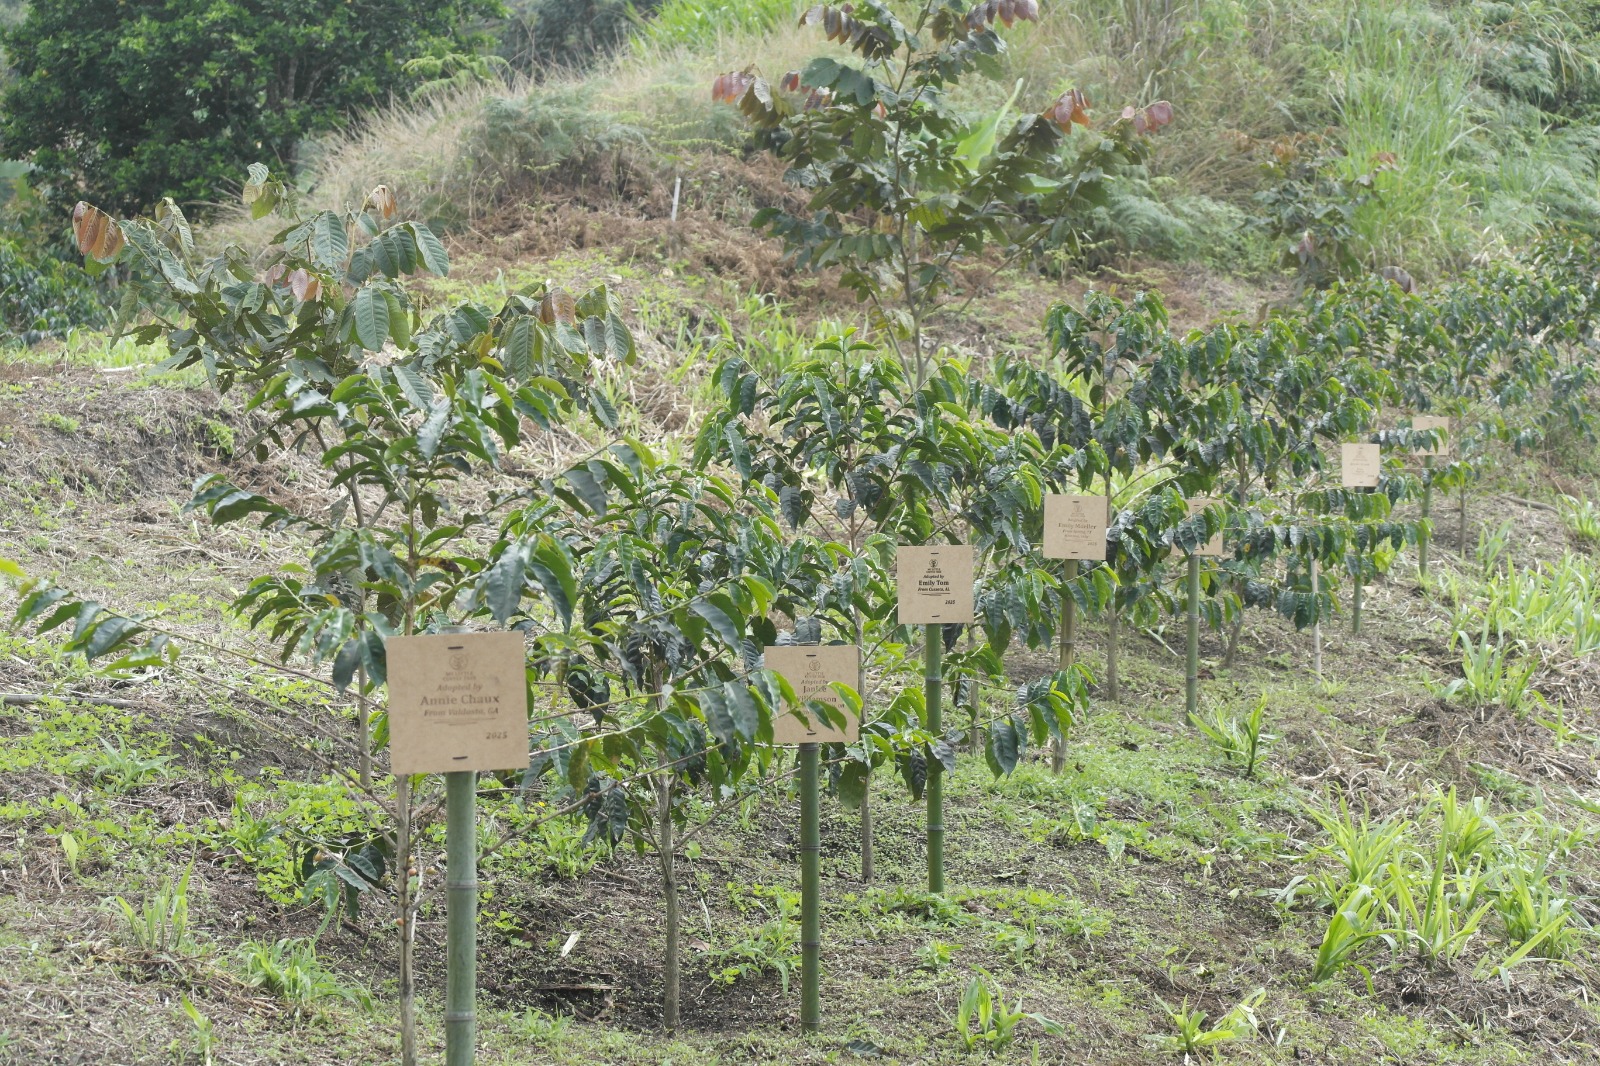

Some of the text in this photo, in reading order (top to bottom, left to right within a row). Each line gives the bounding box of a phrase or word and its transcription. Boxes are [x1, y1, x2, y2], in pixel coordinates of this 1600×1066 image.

[437, 683, 483, 693] Adopted by
[420, 694, 500, 706] Annie Chaux
[424, 709, 446, 717] From
[448, 708, 486, 716] Valdosta,
[486, 731, 508, 740] 2025
